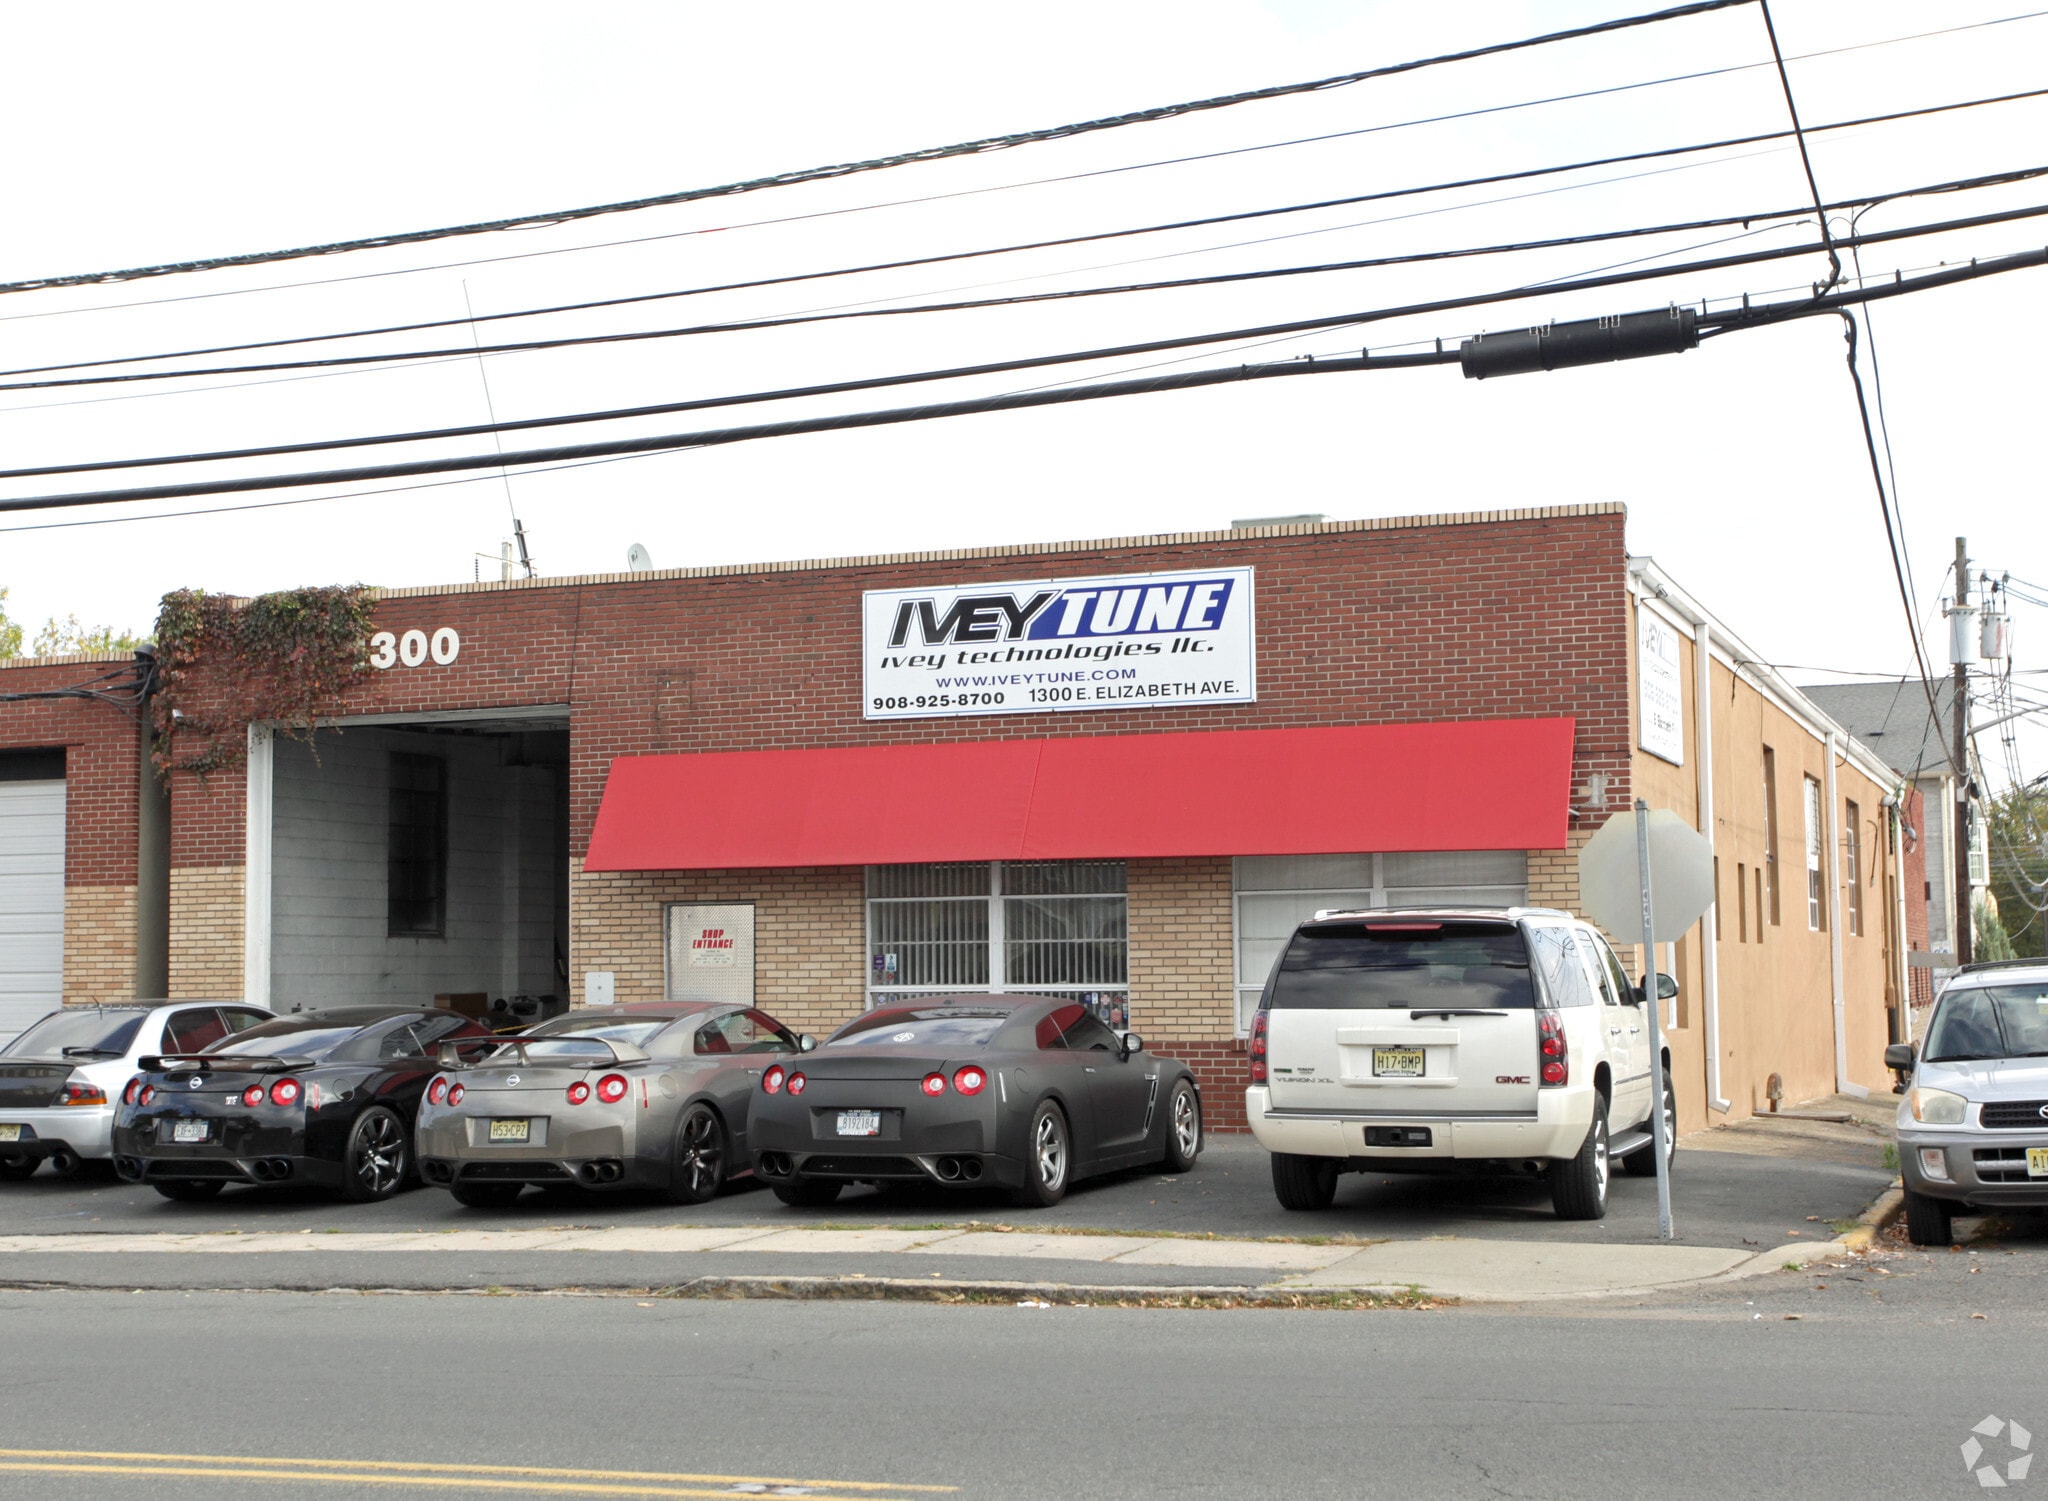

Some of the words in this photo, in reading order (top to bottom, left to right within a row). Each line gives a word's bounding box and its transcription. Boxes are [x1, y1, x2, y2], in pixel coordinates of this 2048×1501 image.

[369, 627, 460, 670] 300
[880, 654, 946, 671] ivey
[957, 641, 1163, 665] technologies
[1171, 637, 1214, 653] llc.
[936, 668, 1137, 688] WWW.IVEYTUNE.COM
[873, 692, 1005, 710] 908-925-8700
[1028, 687, 1072, 702] 1300
[1076, 688, 1091, 700] E.
[1096, 681, 1196, 699] ELIZABETH
[1200, 680, 1240, 694] AVE.
[692, 939, 734, 949] ENTRANCE
[702, 929, 725, 939] SHOP
[1495, 1075, 1531, 1085] GMC
